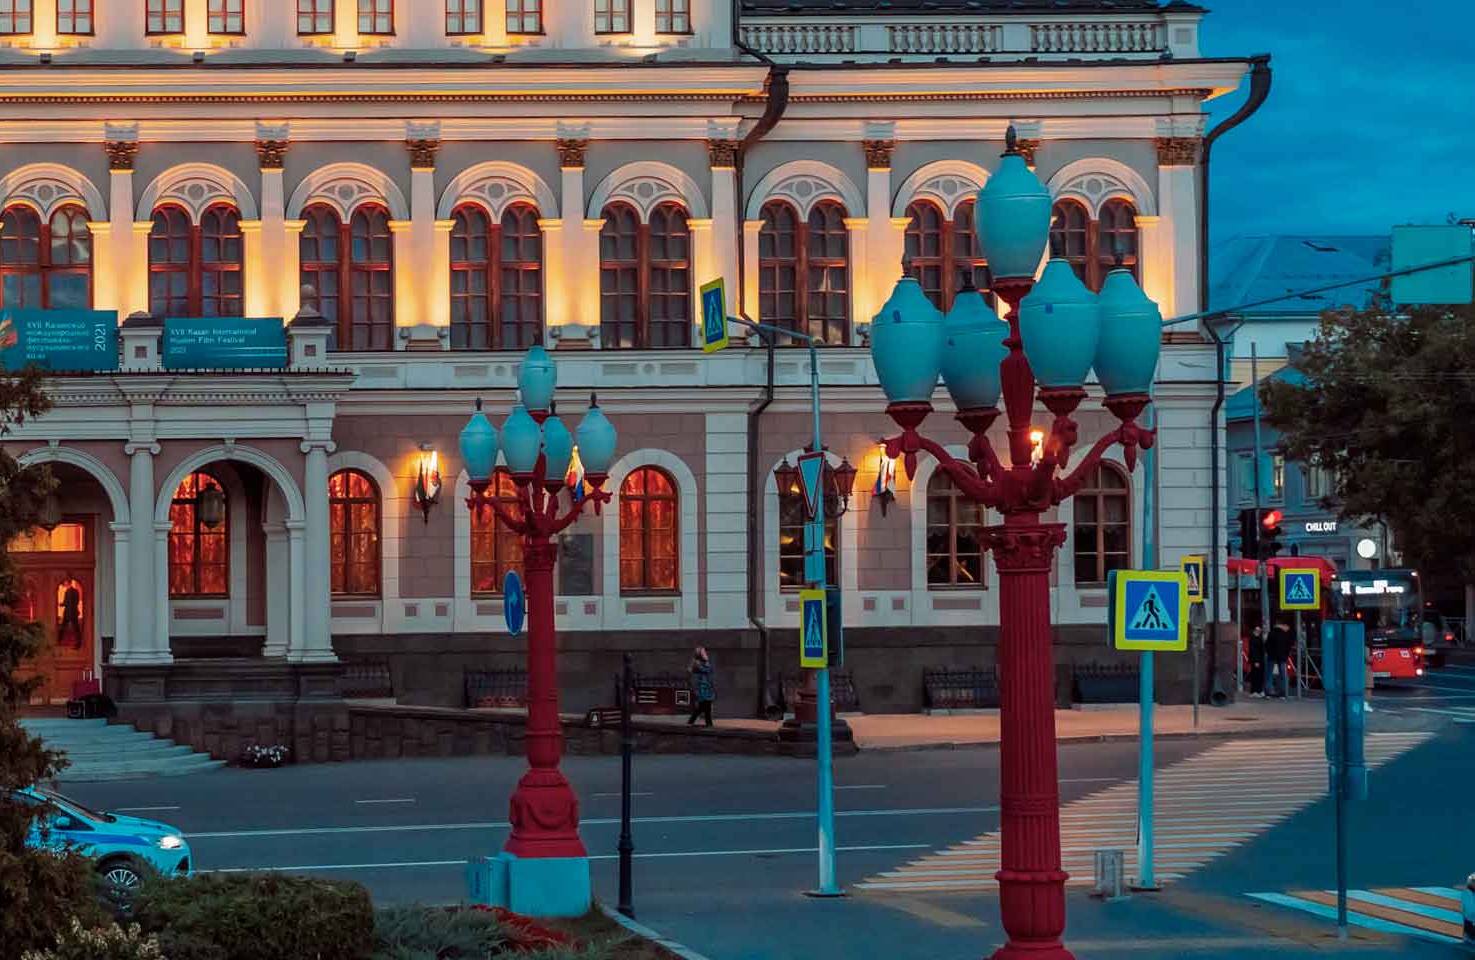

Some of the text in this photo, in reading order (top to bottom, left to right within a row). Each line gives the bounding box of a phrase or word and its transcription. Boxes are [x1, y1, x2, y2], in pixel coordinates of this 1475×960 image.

[187, 328, 209, 336] Kazan
[94, 323, 107, 352] 2021
[198, 336, 215, 344] Film
[218, 336, 245, 344] Festival
[1305, 521, 1337, 532] CHILL OUT
